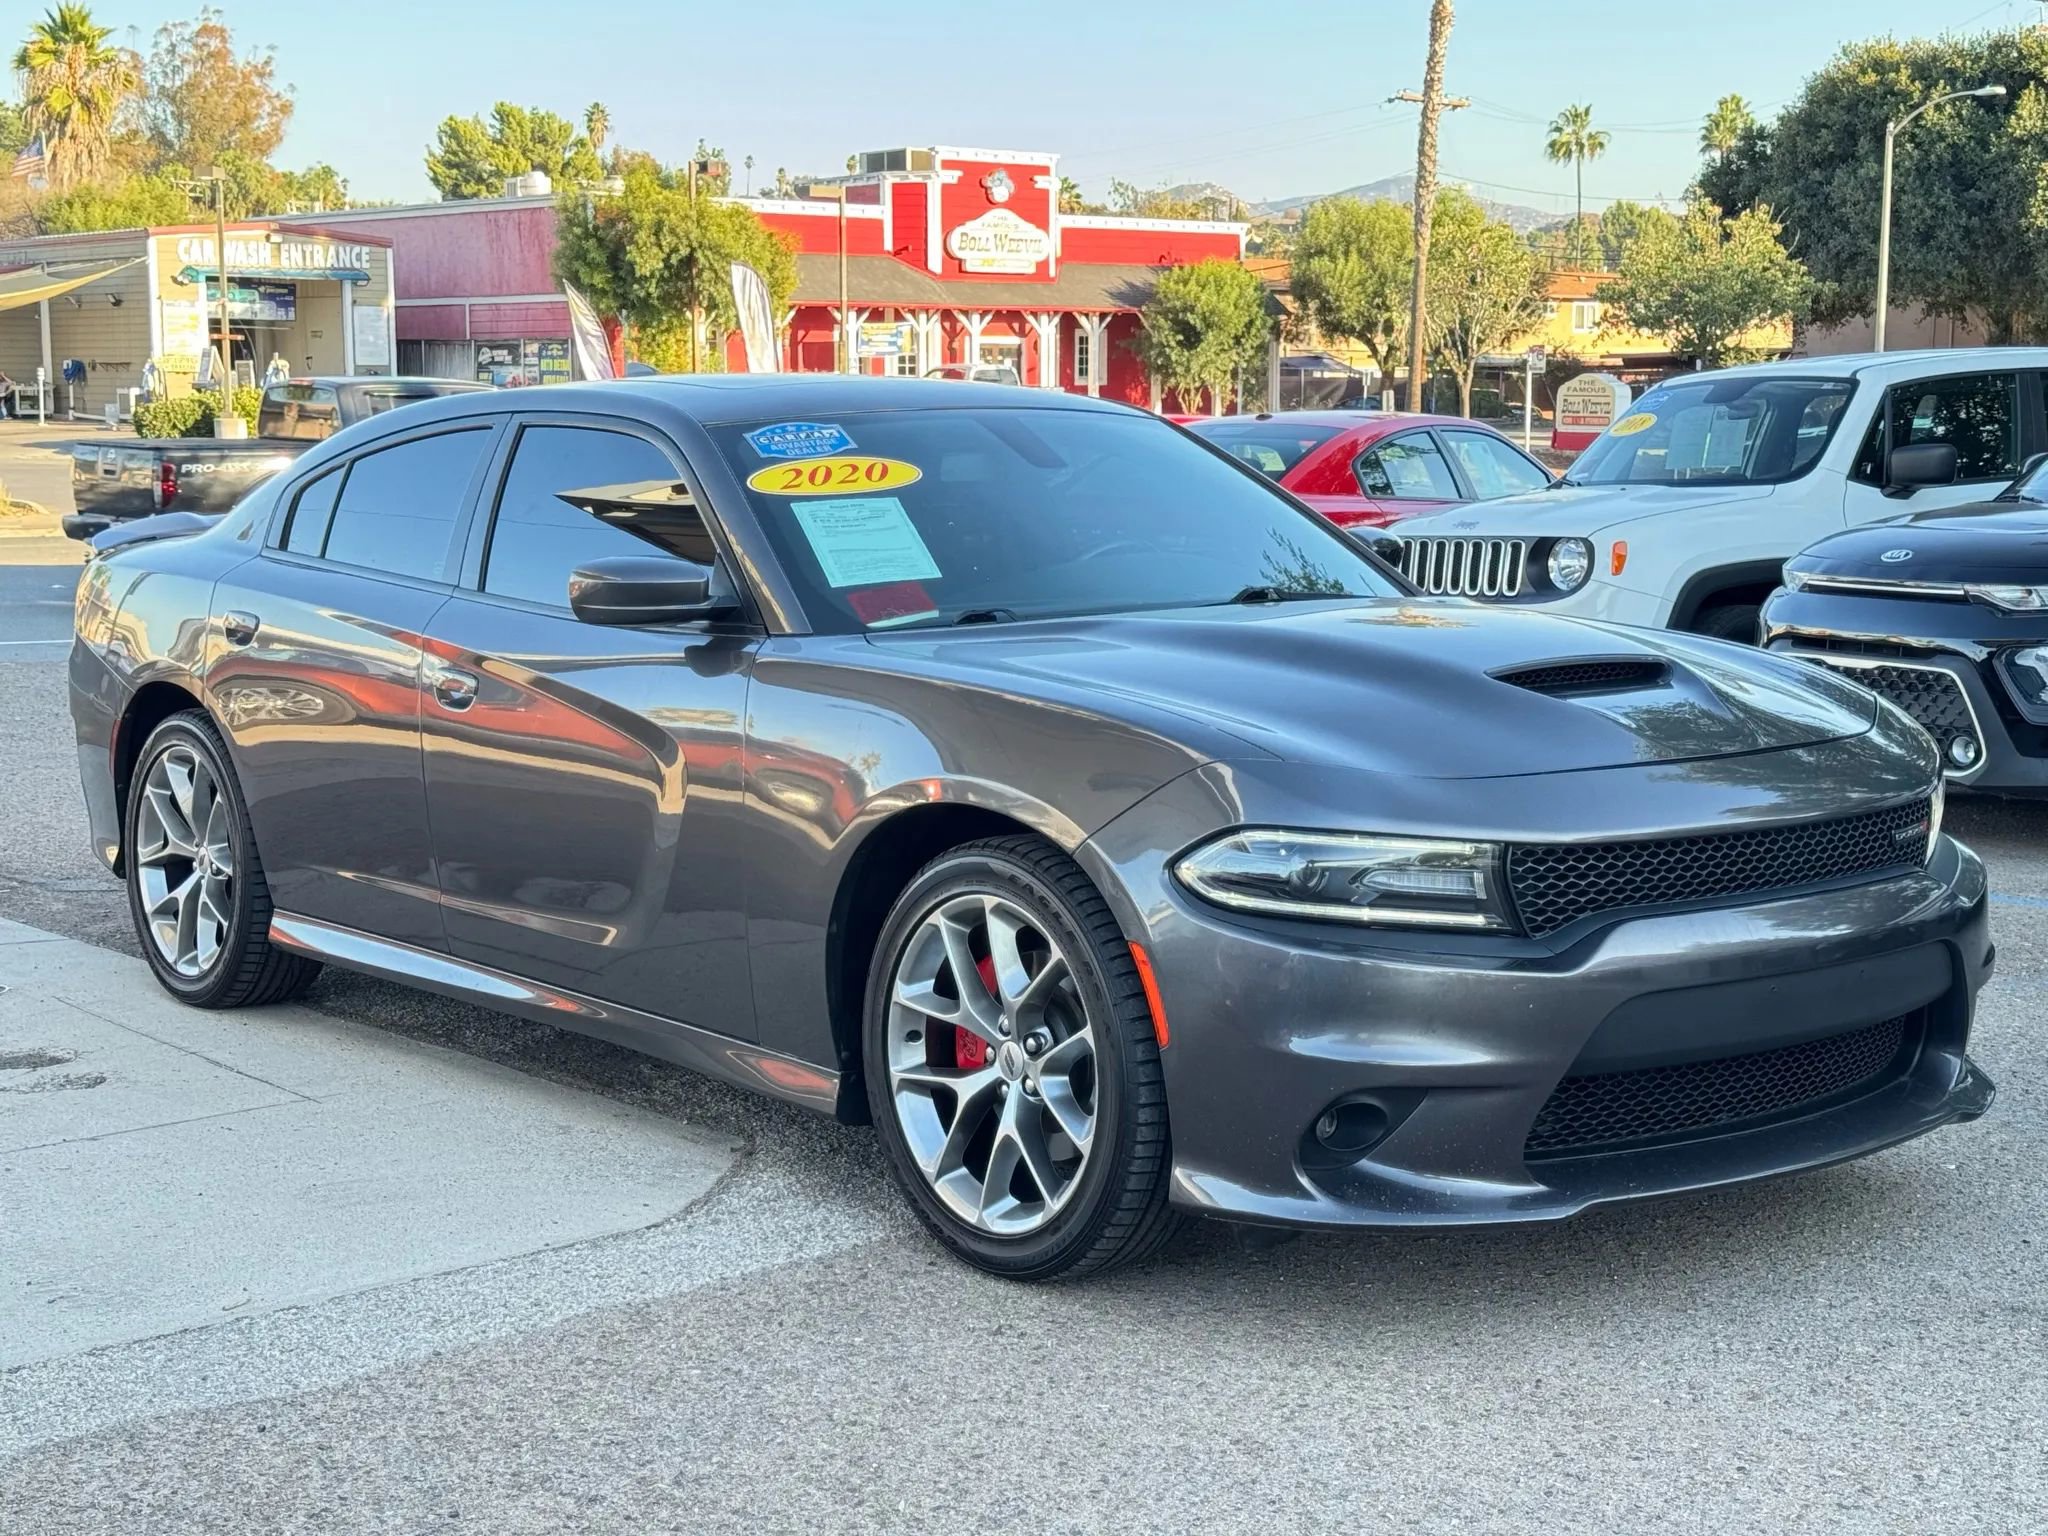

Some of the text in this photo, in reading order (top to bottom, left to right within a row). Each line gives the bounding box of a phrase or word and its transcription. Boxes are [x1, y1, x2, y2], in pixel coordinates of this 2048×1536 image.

[958, 232, 1043, 254] BOLL WEEVIL
[177, 239, 370, 268] CAR WASH ENTRANCE
[1561, 398, 1581, 414] BOLL
[770, 438, 839, 451] ADVANTAGE
[785, 445, 833, 456] DEALER
[780, 462, 889, 490] 2020
